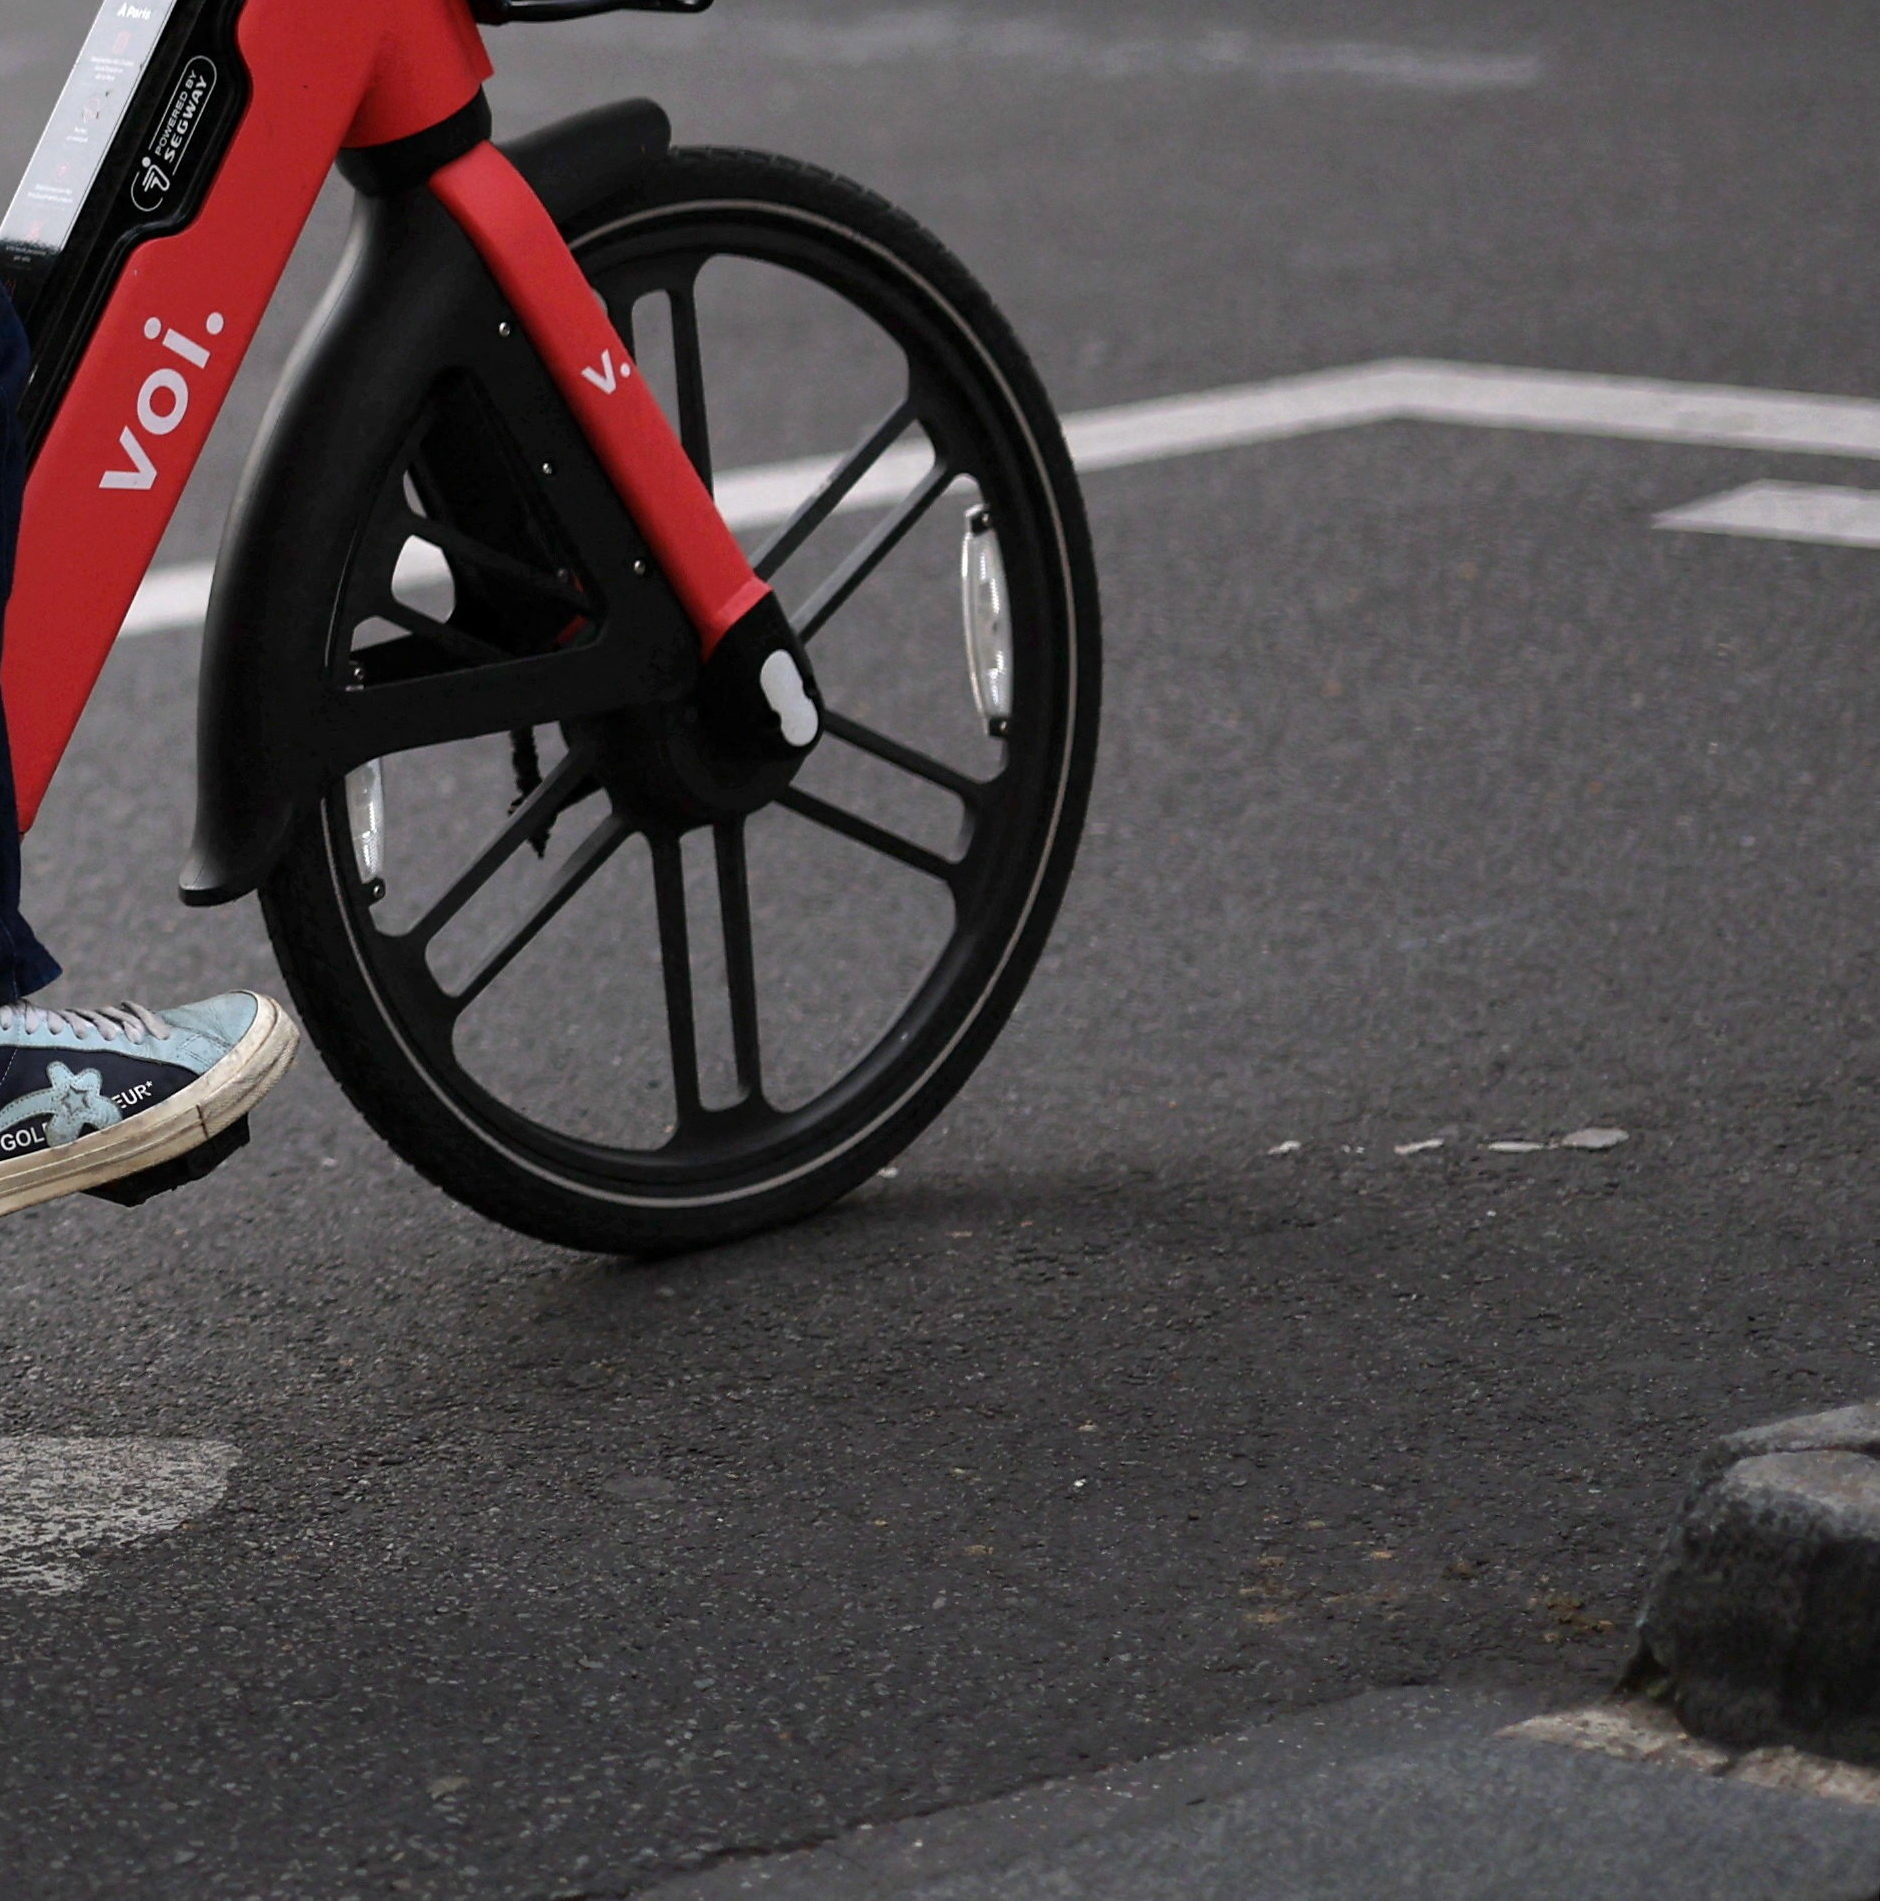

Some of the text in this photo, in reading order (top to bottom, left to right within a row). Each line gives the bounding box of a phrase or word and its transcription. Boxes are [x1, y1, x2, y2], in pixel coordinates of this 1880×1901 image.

[155, 69, 197, 156] POWERED BY
[164, 75, 207, 163] SEGWAY
[99, 312, 224, 490] voi.
[0, 1122, 47, 1151] GOL
